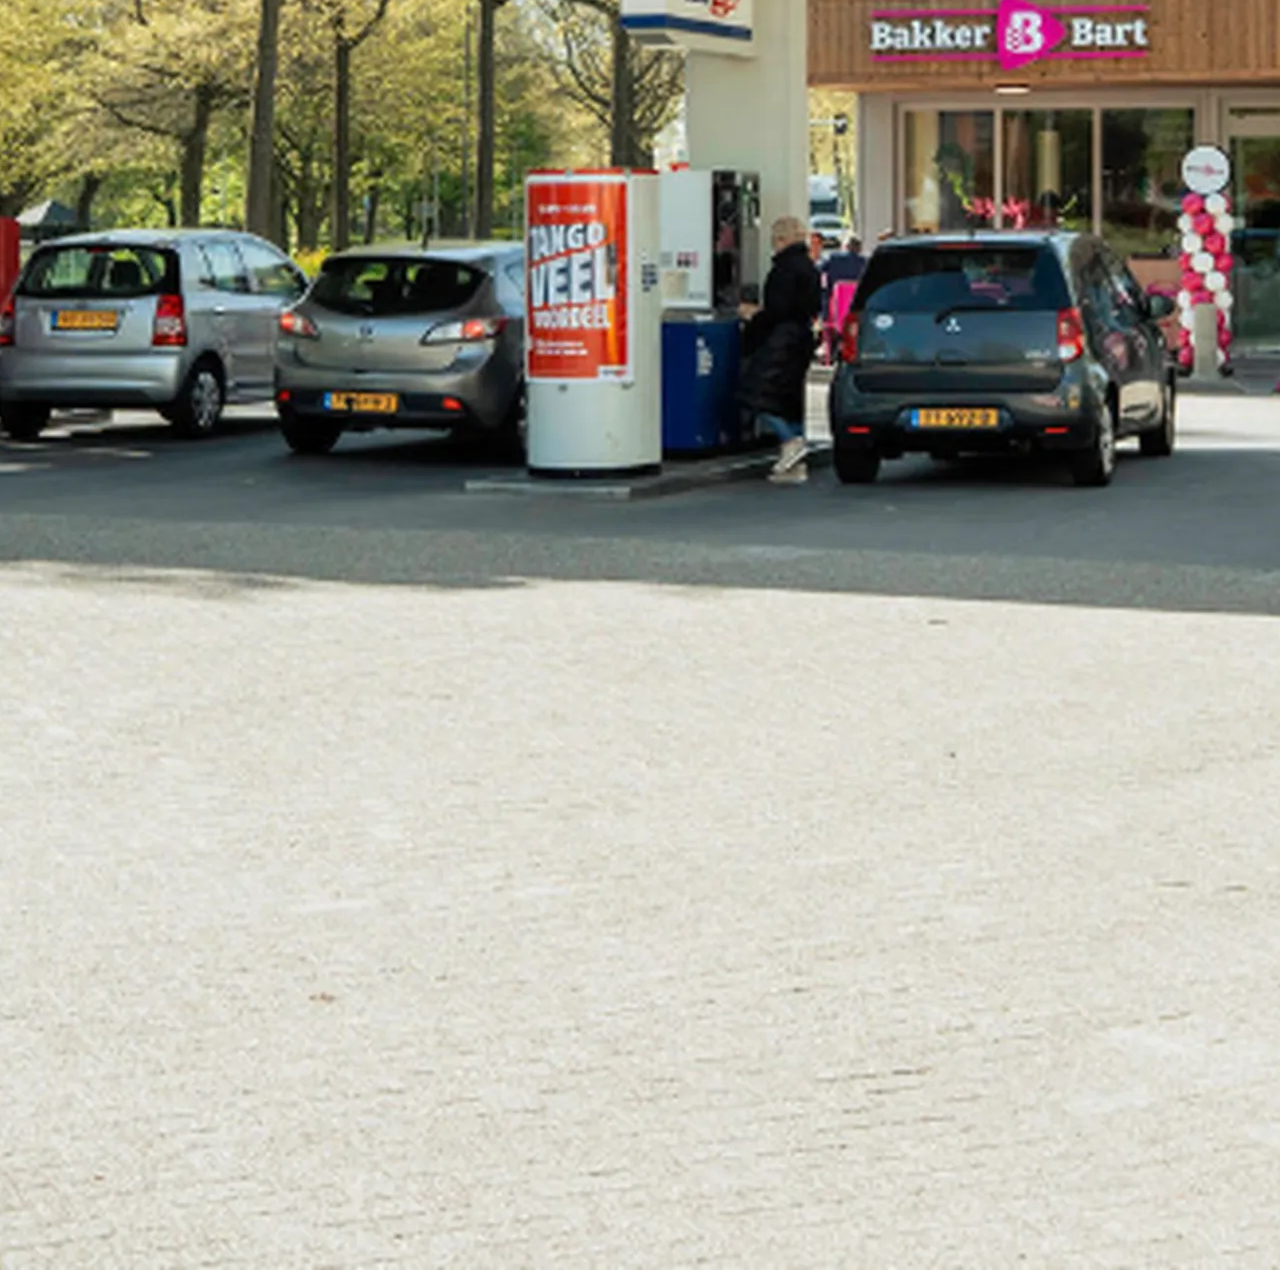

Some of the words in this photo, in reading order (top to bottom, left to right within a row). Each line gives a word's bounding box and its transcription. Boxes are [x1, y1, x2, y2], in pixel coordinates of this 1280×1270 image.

[869, 19, 991, 51] Bakker
[1071, 17, 1148, 47] Bart
[531, 221, 606, 261] TANGO
[531, 245, 616, 308] VEEL
